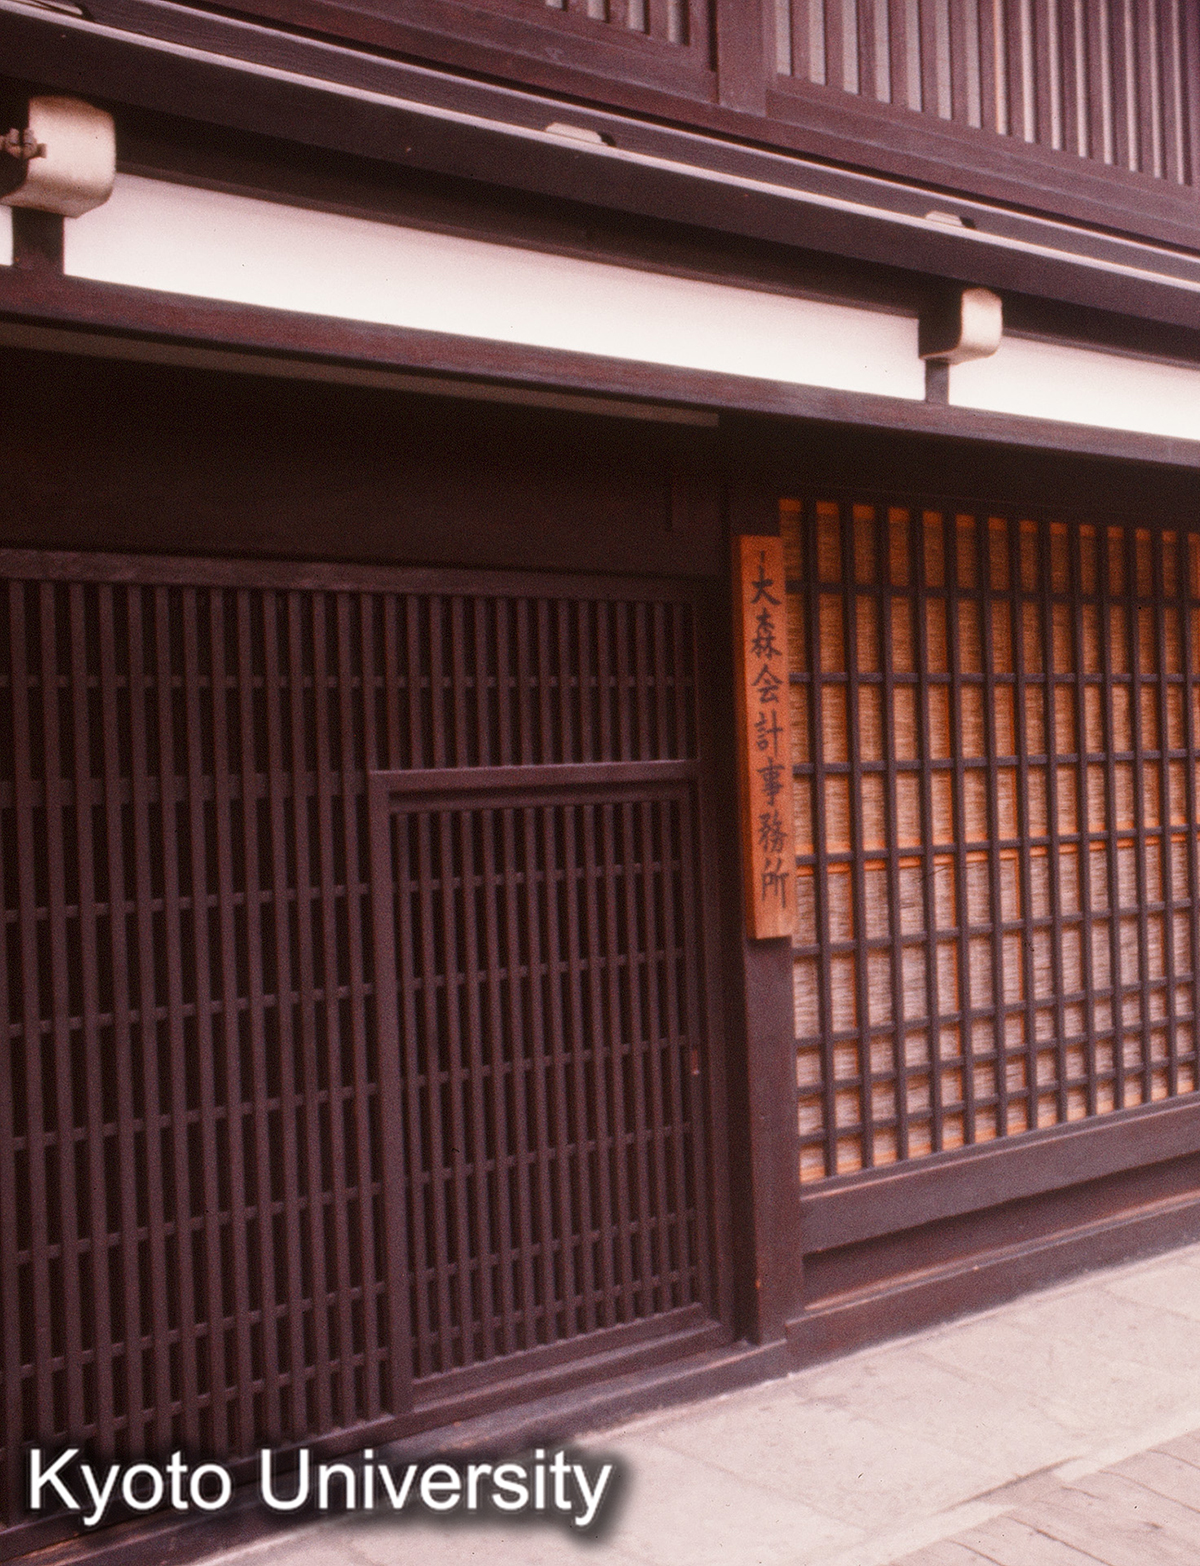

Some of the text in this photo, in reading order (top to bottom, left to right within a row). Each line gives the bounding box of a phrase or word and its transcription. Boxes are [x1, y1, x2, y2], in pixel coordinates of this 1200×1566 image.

[750, 564, 790, 909] 大森会計事務所
